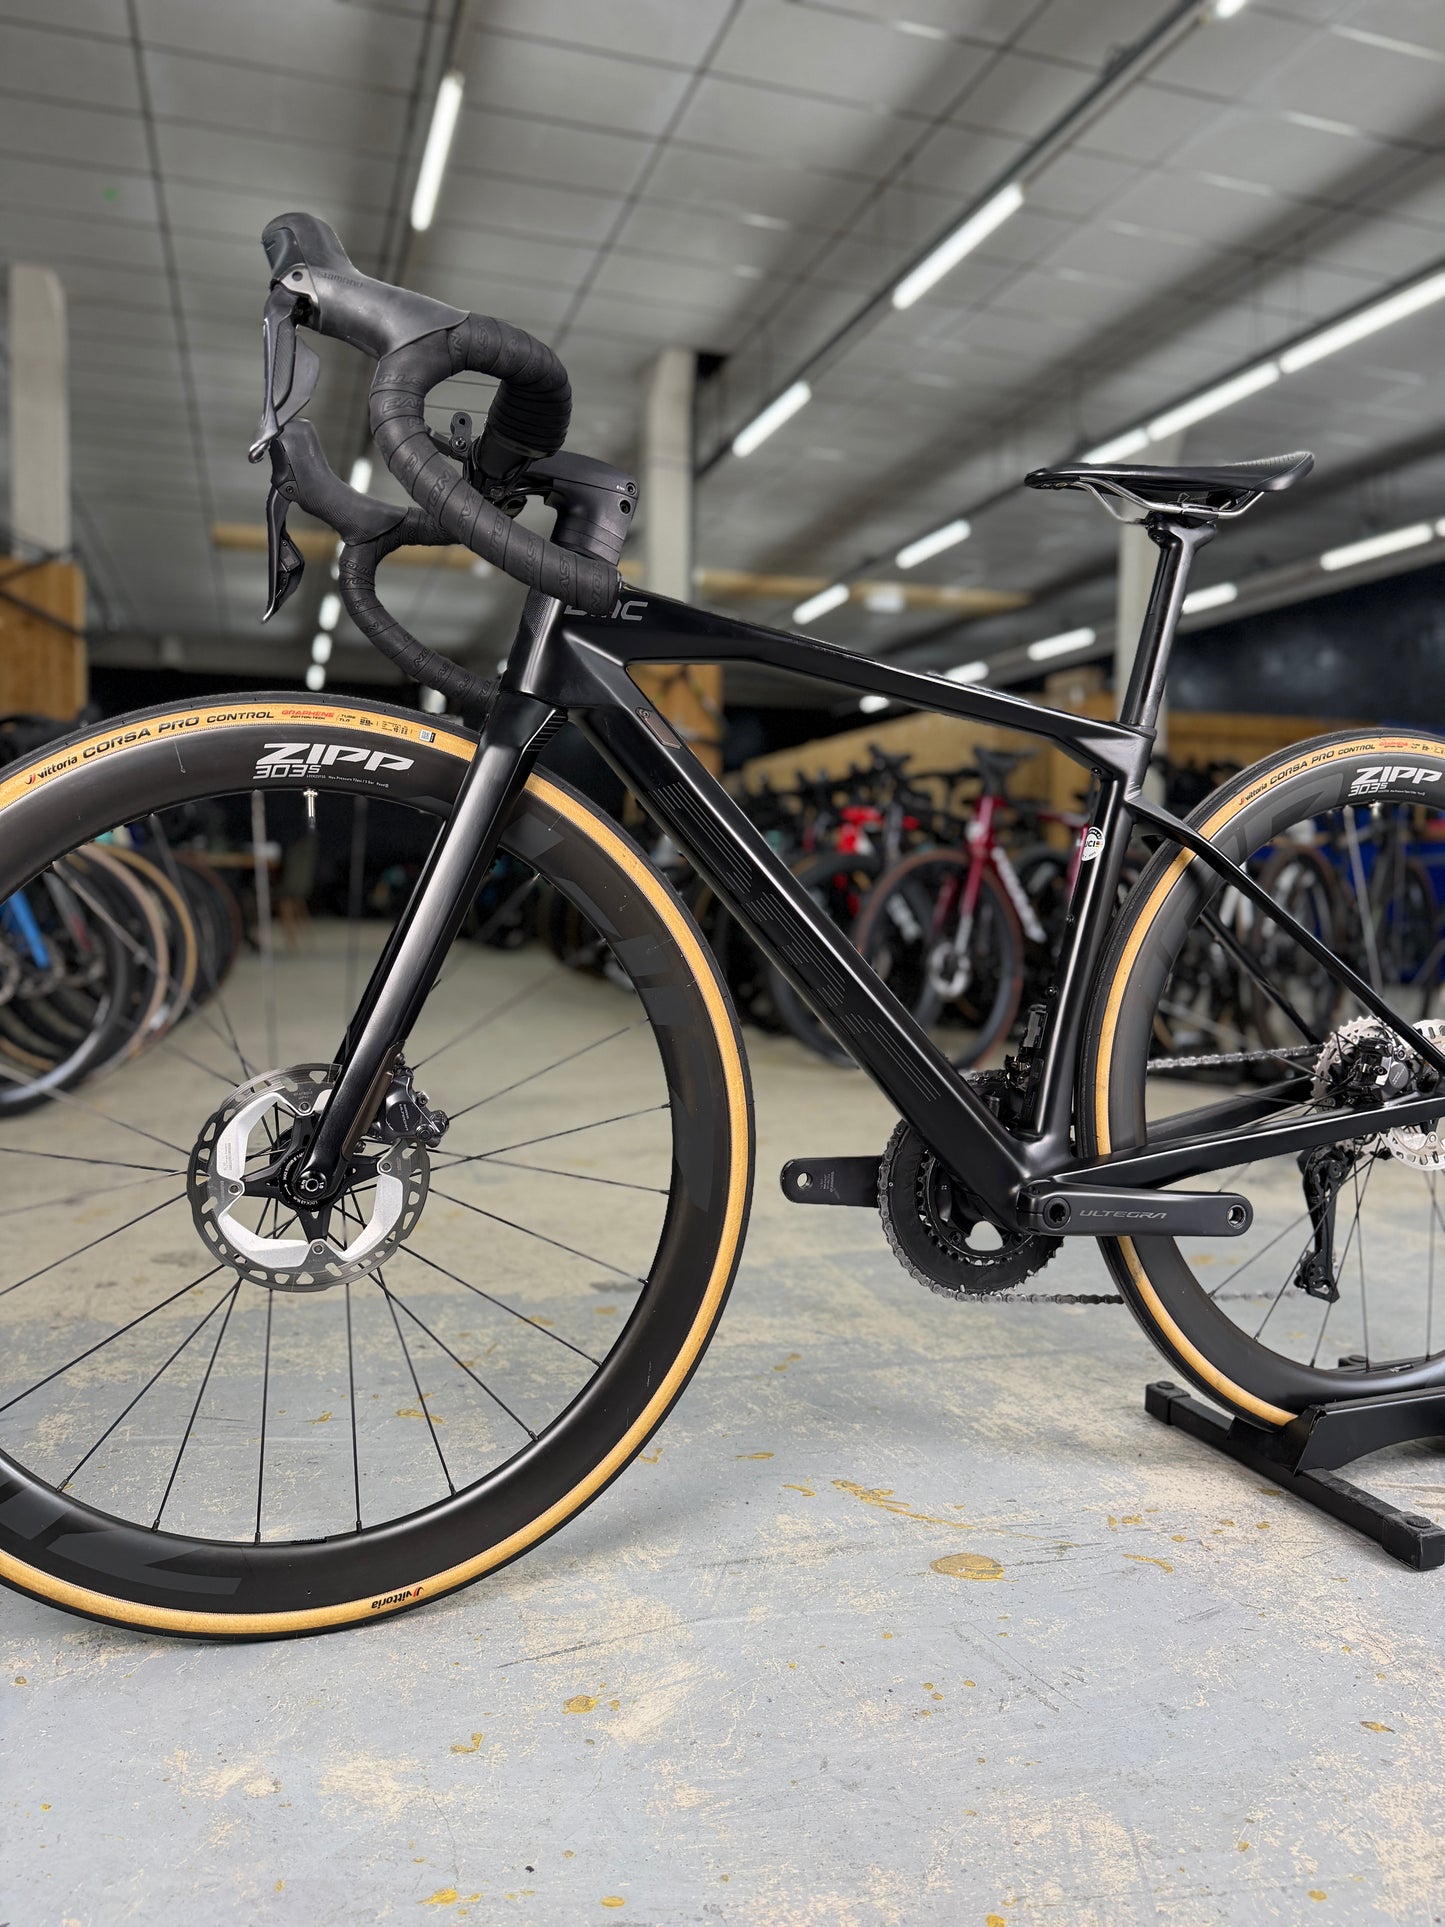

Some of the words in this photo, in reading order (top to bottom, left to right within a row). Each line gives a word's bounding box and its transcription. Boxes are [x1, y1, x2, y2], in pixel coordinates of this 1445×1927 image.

[281, 709, 335, 718] GRAPHENE
[34, 755, 78, 783] vittoria
[82, 728, 151, 759] CORSA
[157, 716, 200, 734] PRO
[206, 711, 275, 724] CONTROL
[256, 743, 414, 772] ZIPP
[1269, 760, 1308, 785] CORSA
[1311, 750, 1335, 764] PRO
[1337, 744, 1375, 755] CONTROL
[1351, 766, 1443, 786] ZIPP
[1079, 1209, 1168, 1219] ULTEGRA
[371, 1590, 412, 1609] vittoria
